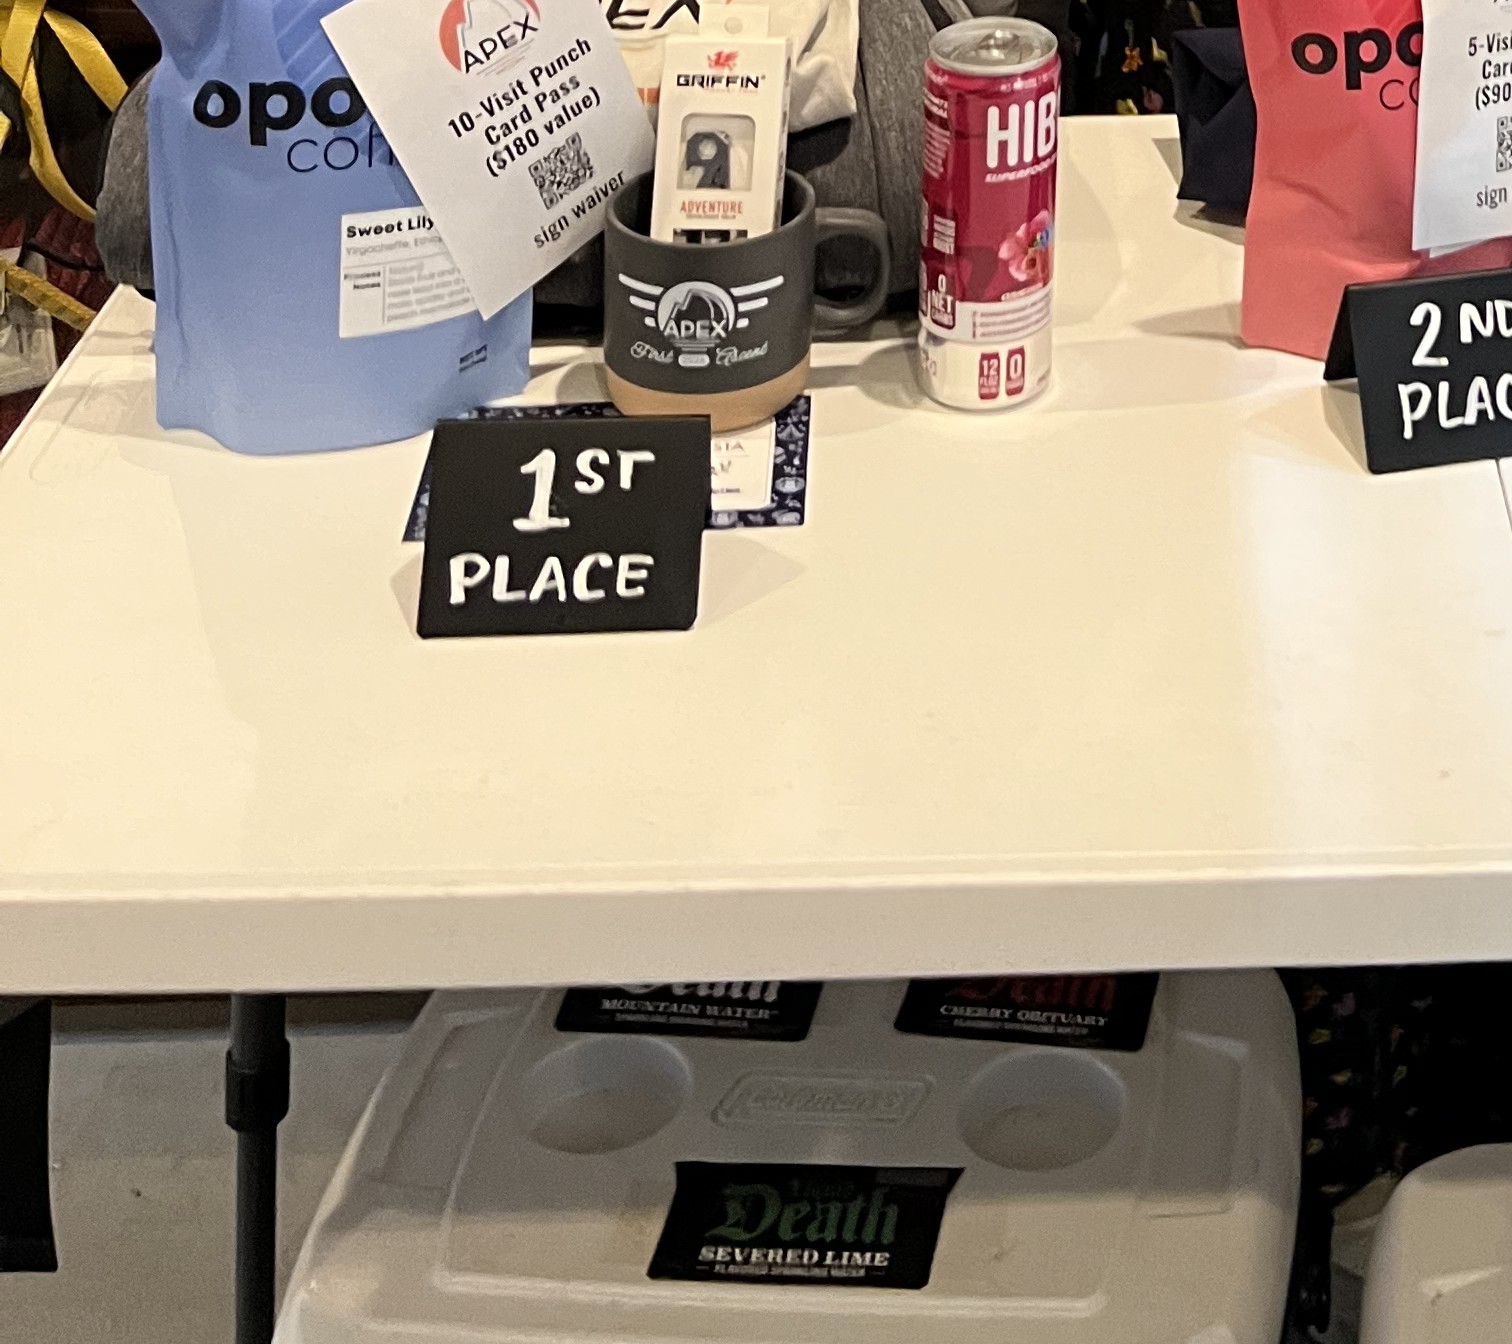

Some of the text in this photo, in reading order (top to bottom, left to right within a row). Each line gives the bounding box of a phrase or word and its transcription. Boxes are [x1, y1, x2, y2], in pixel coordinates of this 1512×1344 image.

[464, 12, 540, 74] APEX
[448, 38, 592, 139] 10-Visit Punch
[676, 73, 760, 89] GRIFFIN
[1474, 81, 1512, 111] ($90
[193, 76, 369, 147] opo
[484, 74, 581, 147] Card Pass
[486, 85, 602, 178] ($180 value)
[533, 170, 626, 249] sign waiver
[680, 199, 743, 214] ADVENTURE
[1476, 184, 1508, 210] sign
[663, 319, 727, 339] APEX
[981, 358, 999, 375] 12
[513, 448, 656, 533] 1ST
[449, 551, 655, 606] PLACE
[600, 999, 771, 1020] MOUNTAIN WATER
[704, 1182, 899, 1245] Death
[698, 1245, 891, 1267] SEVERED LIME
